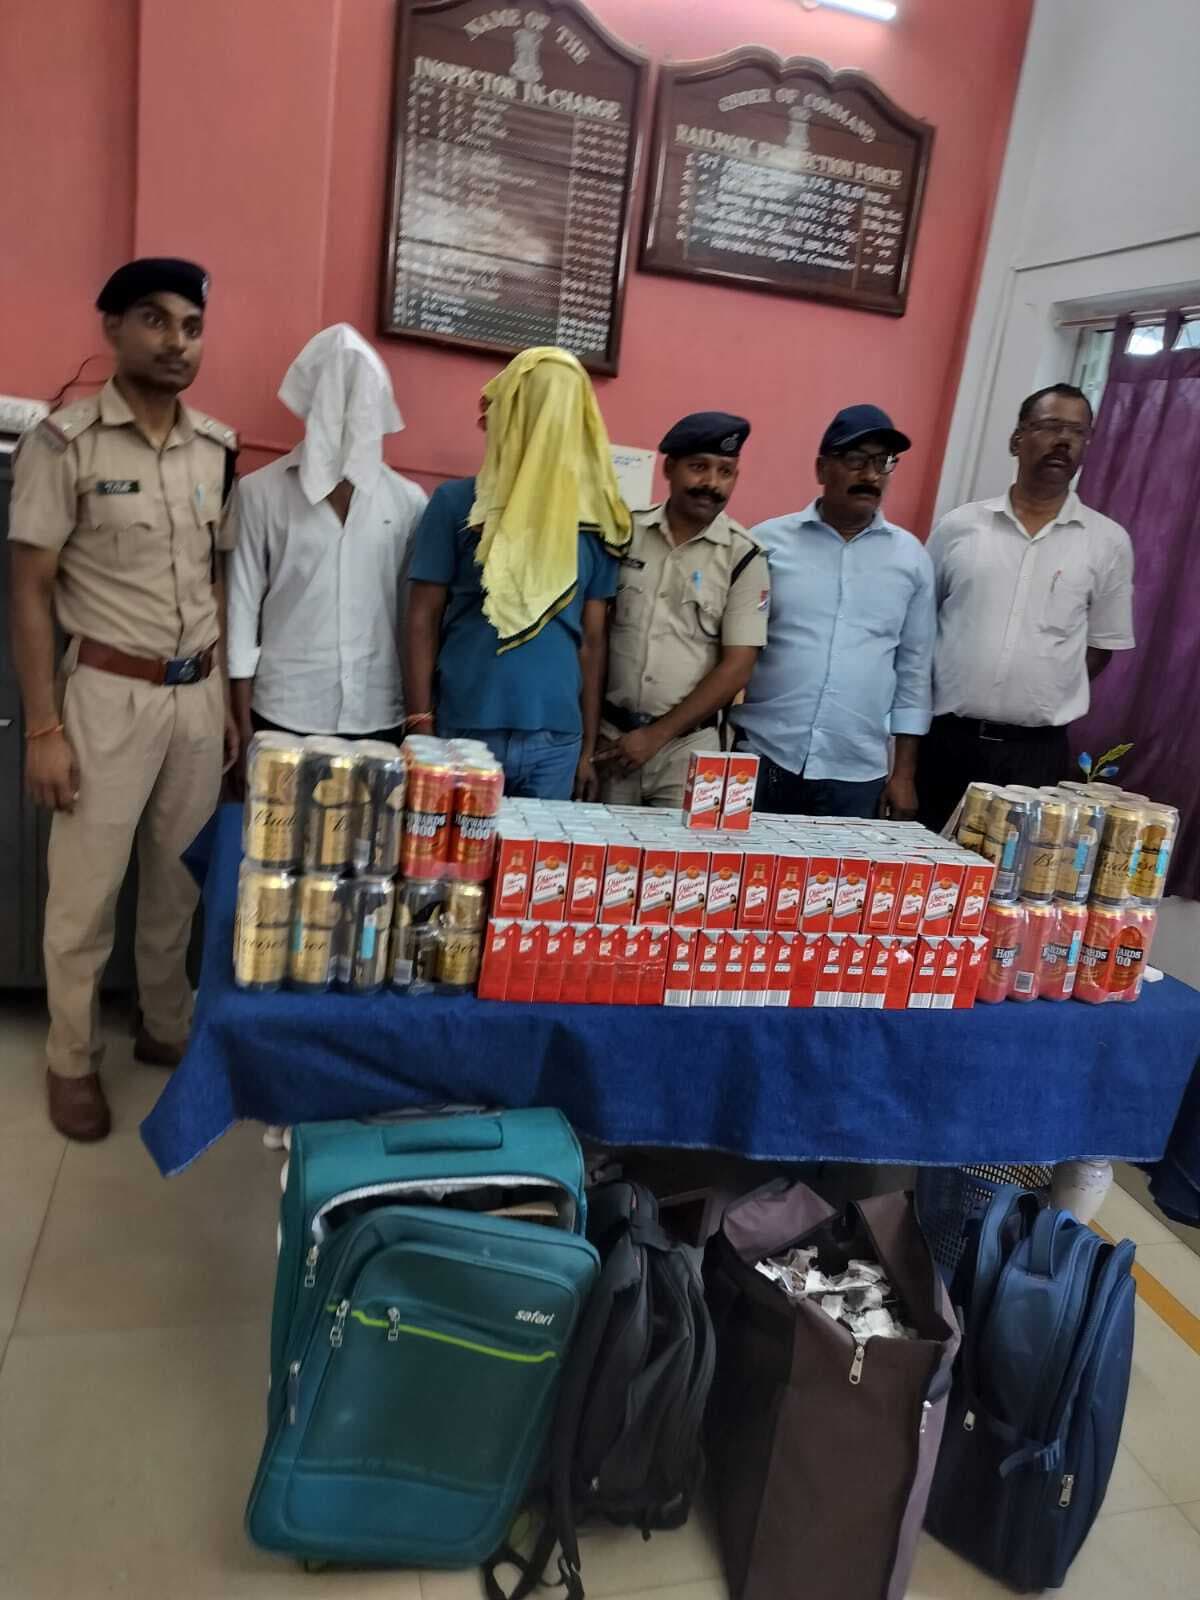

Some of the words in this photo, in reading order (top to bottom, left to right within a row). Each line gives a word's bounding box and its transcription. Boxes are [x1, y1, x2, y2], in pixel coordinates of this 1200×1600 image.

[463, 8, 521, 41] NAME
[524, 11, 551, 31] OF
[555, 25, 590, 64] THE
[414, 56, 517, 99] INSPECTOR
[775, 88, 800, 104] OF
[803, 93, 877, 143] COMMAND
[676, 124, 757, 157] RAILWAY
[854, 162, 903, 186] FORCE
[514, 1309, 555, 1326] safari
